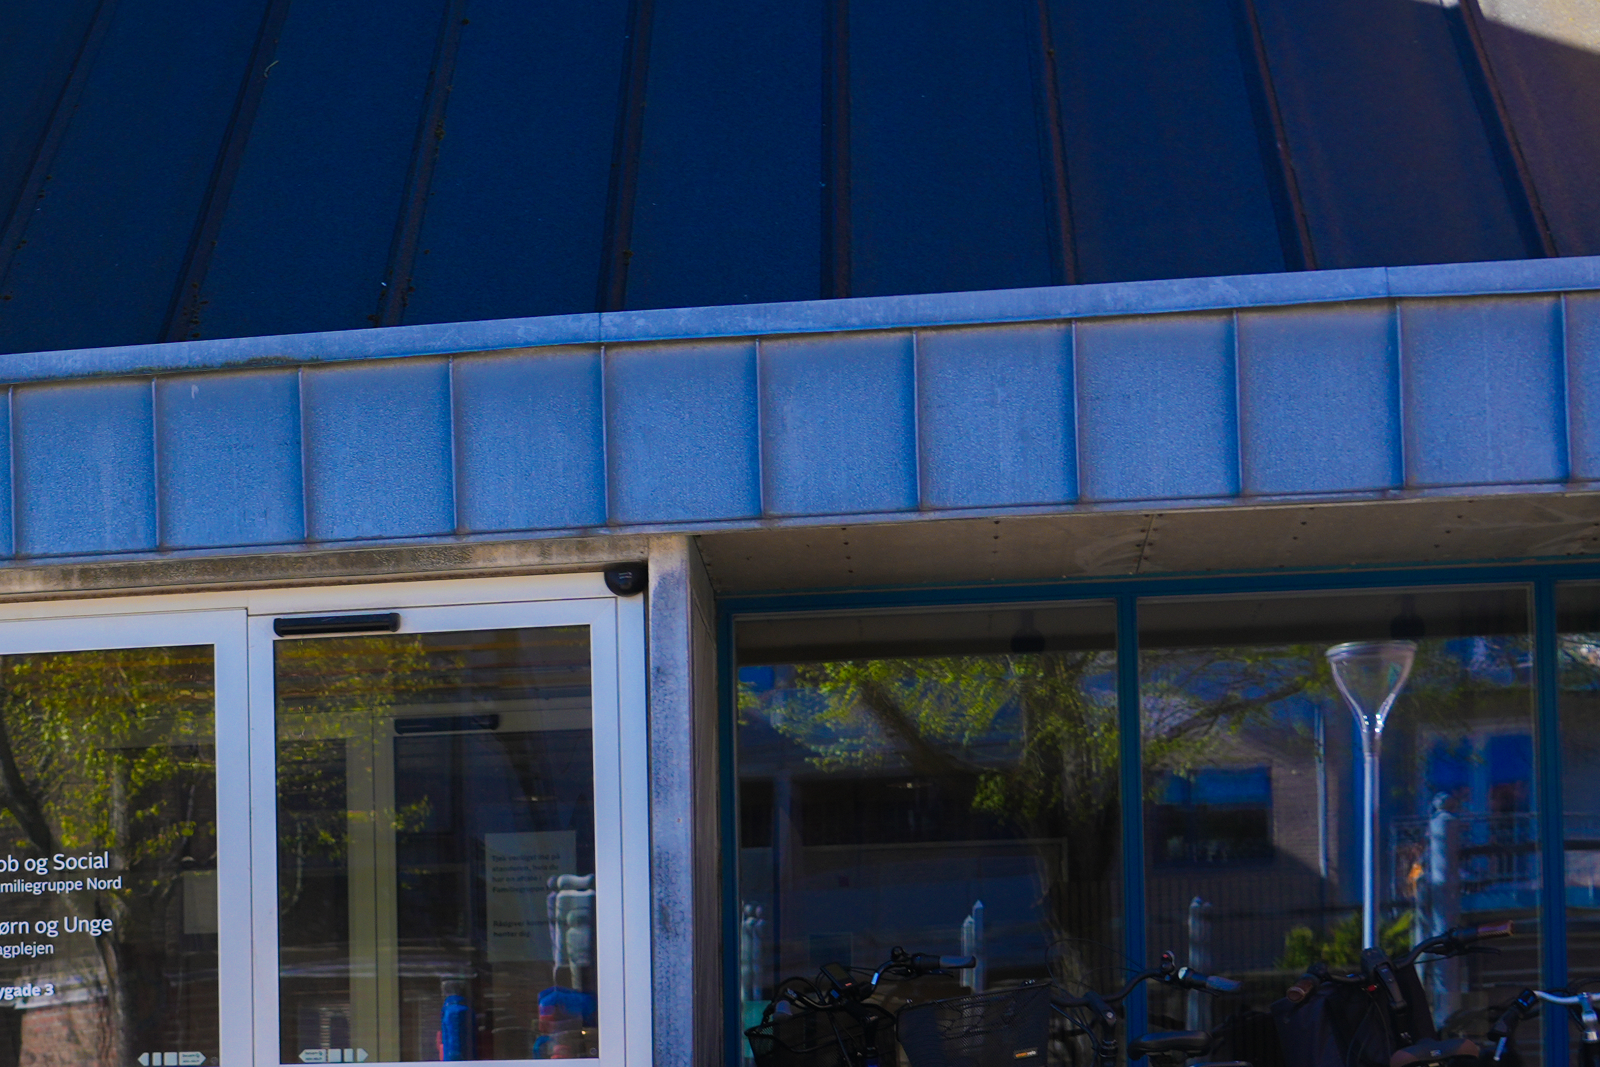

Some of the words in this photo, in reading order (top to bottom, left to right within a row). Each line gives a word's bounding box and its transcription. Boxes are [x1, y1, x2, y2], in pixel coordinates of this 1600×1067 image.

[24, 857, 49, 875] og
[53, 851, 109, 870] Social
[86, 875, 122, 890] Nord
[34, 920, 59, 937] og
[63, 916, 113, 936] Unge
[43, 983, 55, 996] 3
